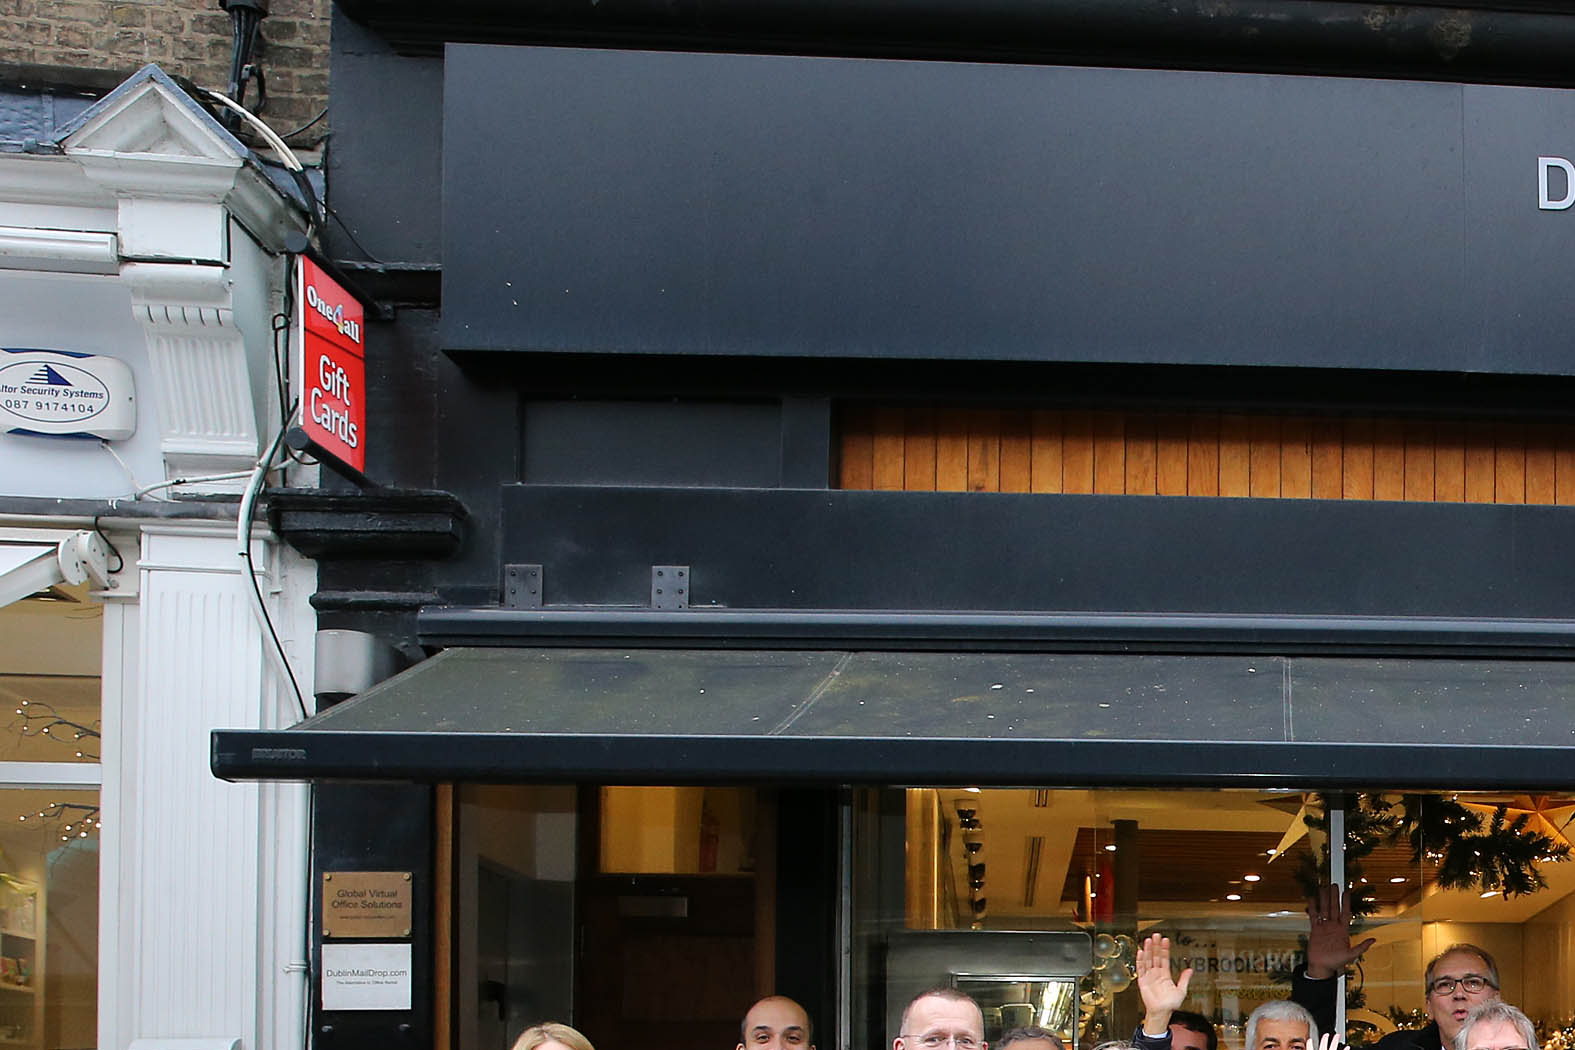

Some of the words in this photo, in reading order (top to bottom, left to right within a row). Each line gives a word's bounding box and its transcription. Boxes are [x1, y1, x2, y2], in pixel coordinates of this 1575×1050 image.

[319, 354, 351, 407] Gift
[0, 384, 18, 394] ltor
[20, 385, 60, 398] Security
[62, 388, 104, 400] Systems
[5, 399, 29, 409] 087
[35, 401, 94, 413] 9174104
[311, 387, 358, 448] Cards
[336, 889, 366, 898] Global
[369, 889, 398, 898] Virtual
[331, 900, 359, 909] Office
[359, 900, 403, 909] Solutions
[326, 969, 408, 978] DublinMailDrop.com
